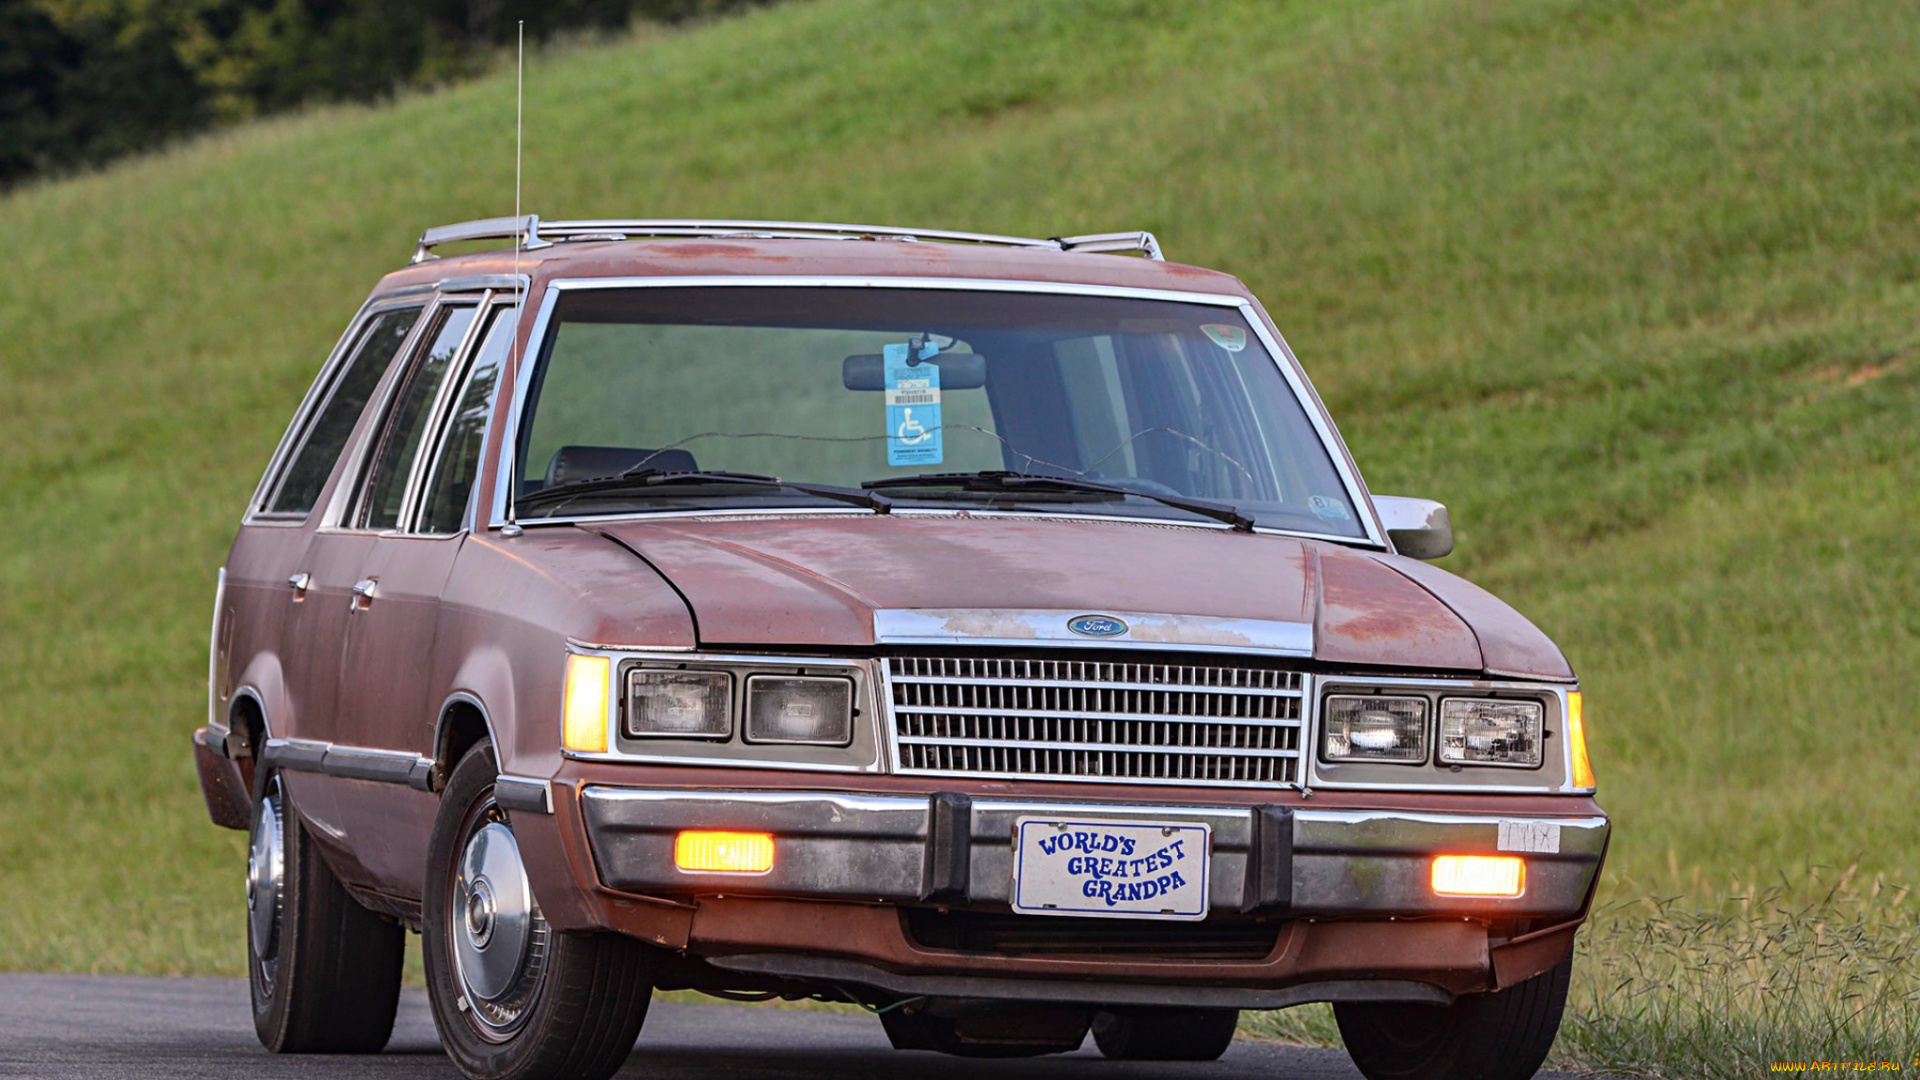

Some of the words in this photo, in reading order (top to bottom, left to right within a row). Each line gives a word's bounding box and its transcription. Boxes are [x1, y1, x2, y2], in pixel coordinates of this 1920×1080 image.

[1084, 620, 1112, 631] Ford
[1038, 831, 1136, 855] WORLD'S
[1068, 840, 1185, 879] GREATEST
[1082, 871, 1186, 906] GRANDPA
